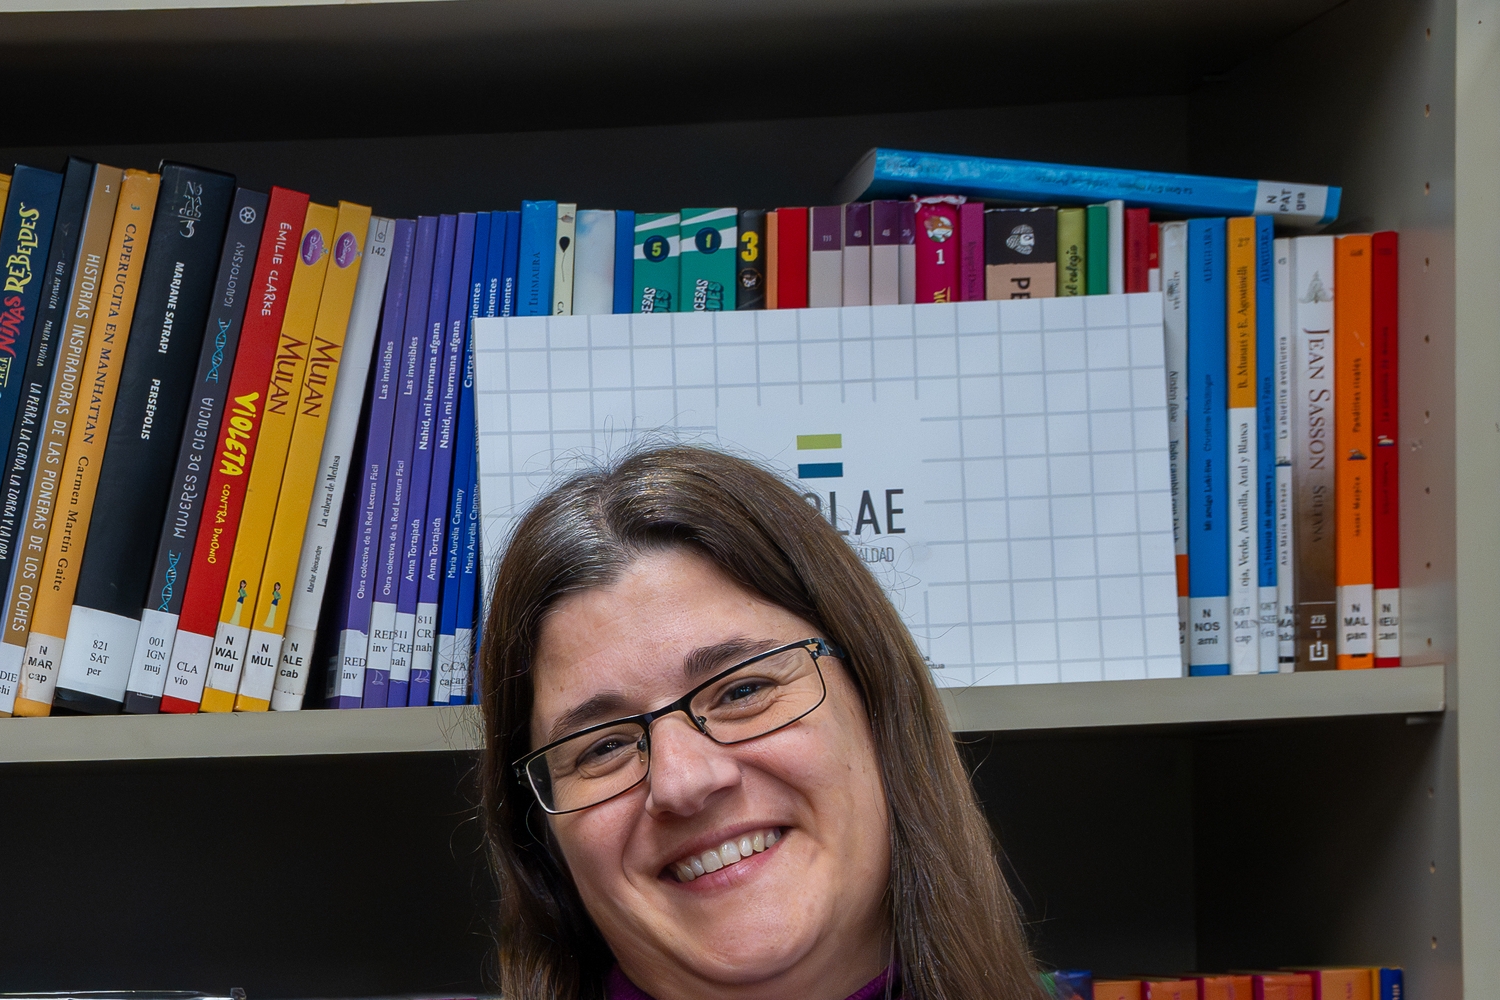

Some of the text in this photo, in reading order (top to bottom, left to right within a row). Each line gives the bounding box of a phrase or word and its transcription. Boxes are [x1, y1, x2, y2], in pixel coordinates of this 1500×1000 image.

[4, 202, 40, 293] REBELDES
[273, 222, 292, 265] ÉMILIE
[652, 243, 661, 256] 5
[706, 234, 711, 247] 1
[741, 231, 758, 261] 3
[936, 250, 945, 264] 1
[262, 270, 278, 316] CLARKE
[141, 262, 185, 440] MARJANE SATRAPI PERSÉPOLIS
[173, 242, 246, 539] MUJERES DE CIENCIA IGNOTOFSKY
[267, 333, 308, 415] MULAN
[419, 322, 440, 450] Nahid, mi hermana afgana
[53, 224, 137, 592] CAPERUCITA EN MANHATTAN Carmen Martín Gaite
[1303, 328, 1332, 471] JEAN SASSON
[12, 254, 101, 632] HISTORIAS INSPIRADORAS DE LAS PIONERAS DE LOS COCHES
[216, 484, 230, 523] CONTRA
[1195, 622, 1220, 631] NOS
[1198, 637, 1218, 645] ami
[90, 653, 109, 664] SAT
[92, 640, 108, 650] 821
[215, 647, 238, 660] WAL
[87, 667, 101, 676] per
[214, 662, 234, 672] mul
